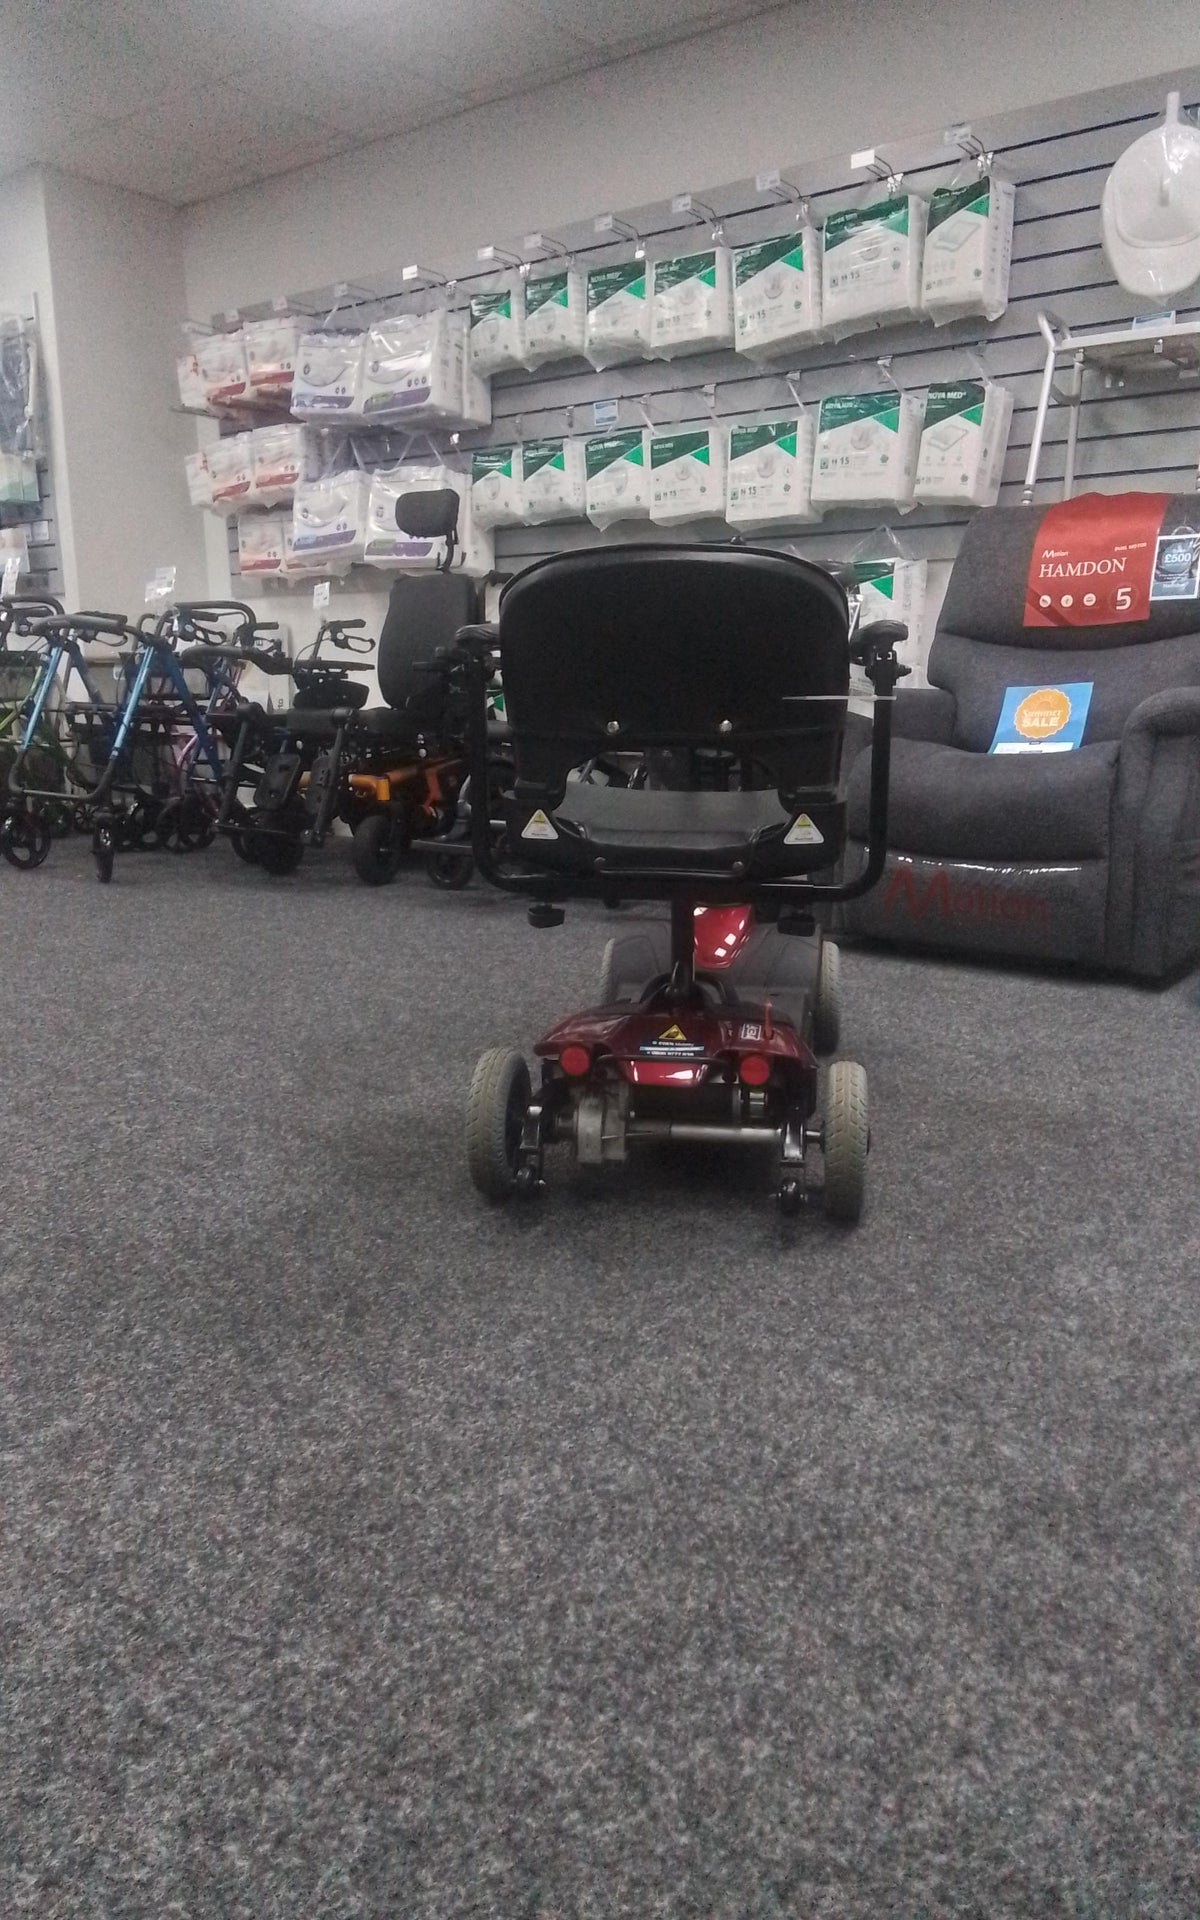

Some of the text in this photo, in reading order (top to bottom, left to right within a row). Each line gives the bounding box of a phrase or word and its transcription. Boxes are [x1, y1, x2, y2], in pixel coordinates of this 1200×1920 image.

[748, 486, 757, 496] 15
[1164, 552, 1192, 564] £500
[1038, 556, 1128, 578] HAMDON
[1115, 587, 1132, 611] 5
[1021, 716, 1060, 728] SALE
